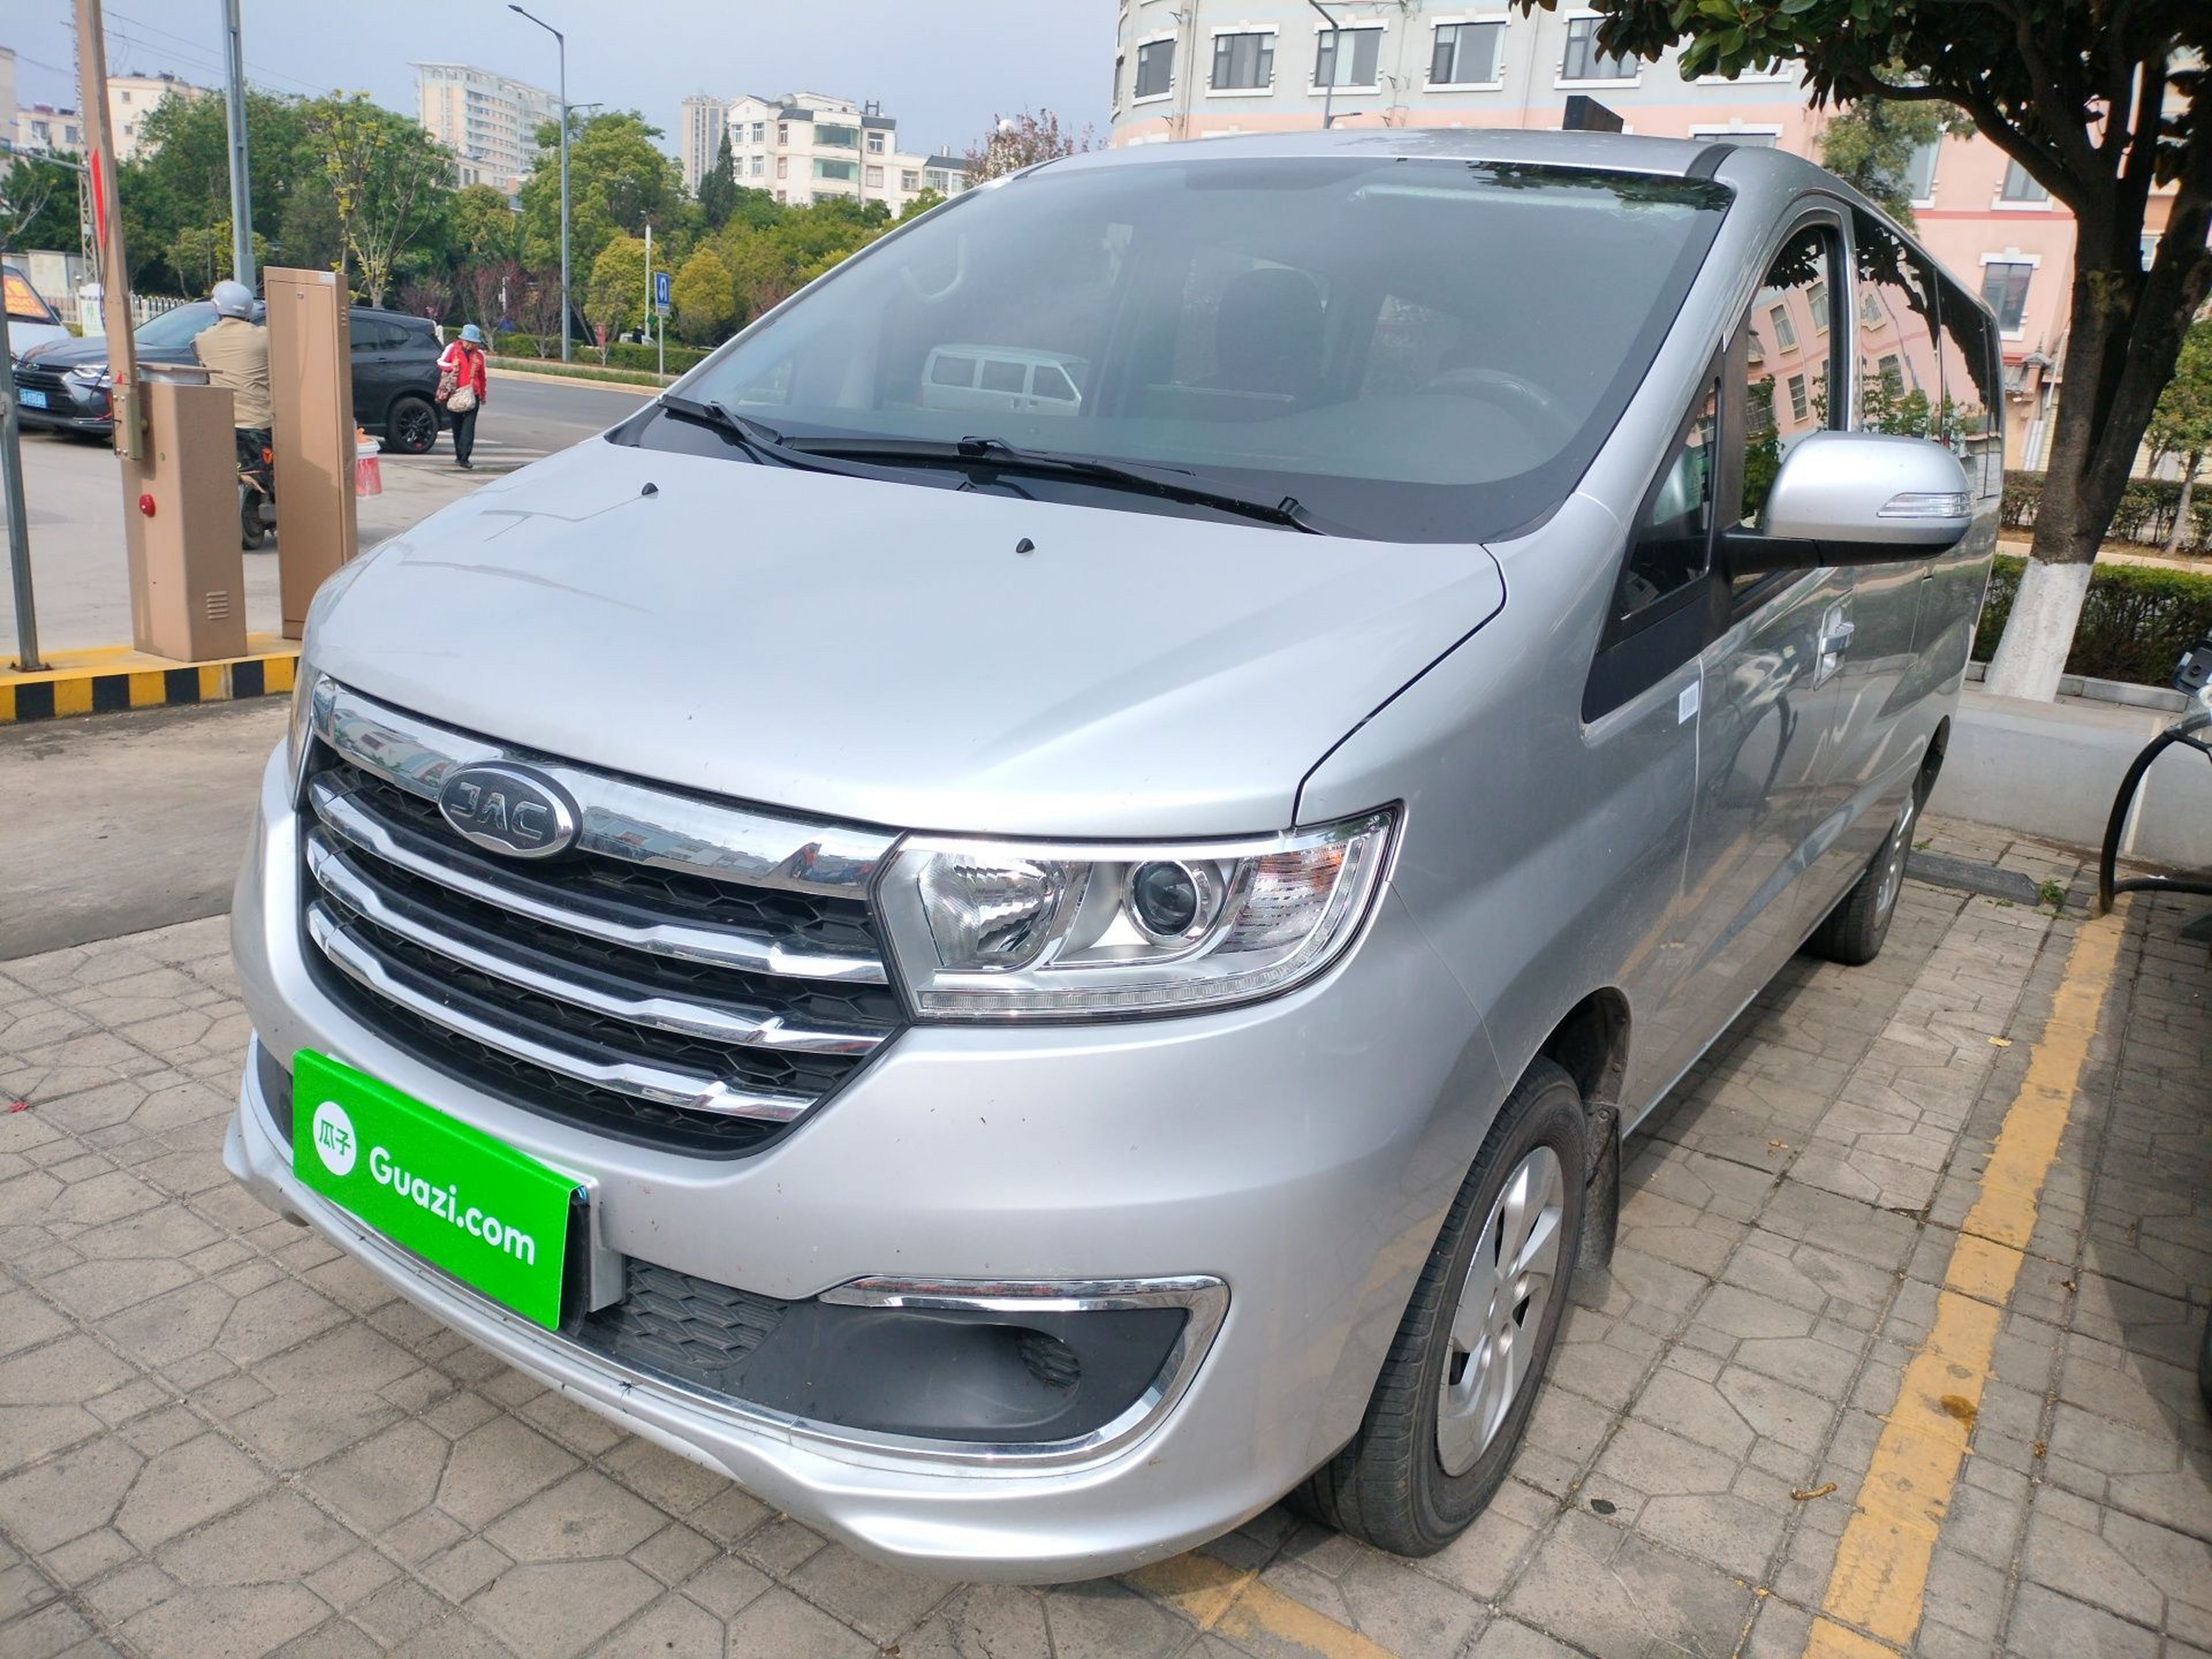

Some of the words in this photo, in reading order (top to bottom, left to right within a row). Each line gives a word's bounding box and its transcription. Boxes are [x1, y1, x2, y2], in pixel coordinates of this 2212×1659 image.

[450, 782, 548, 840] JAC
[319, 1119, 351, 1156] 瓜子
[369, 1147, 536, 1266] Guazi.com
